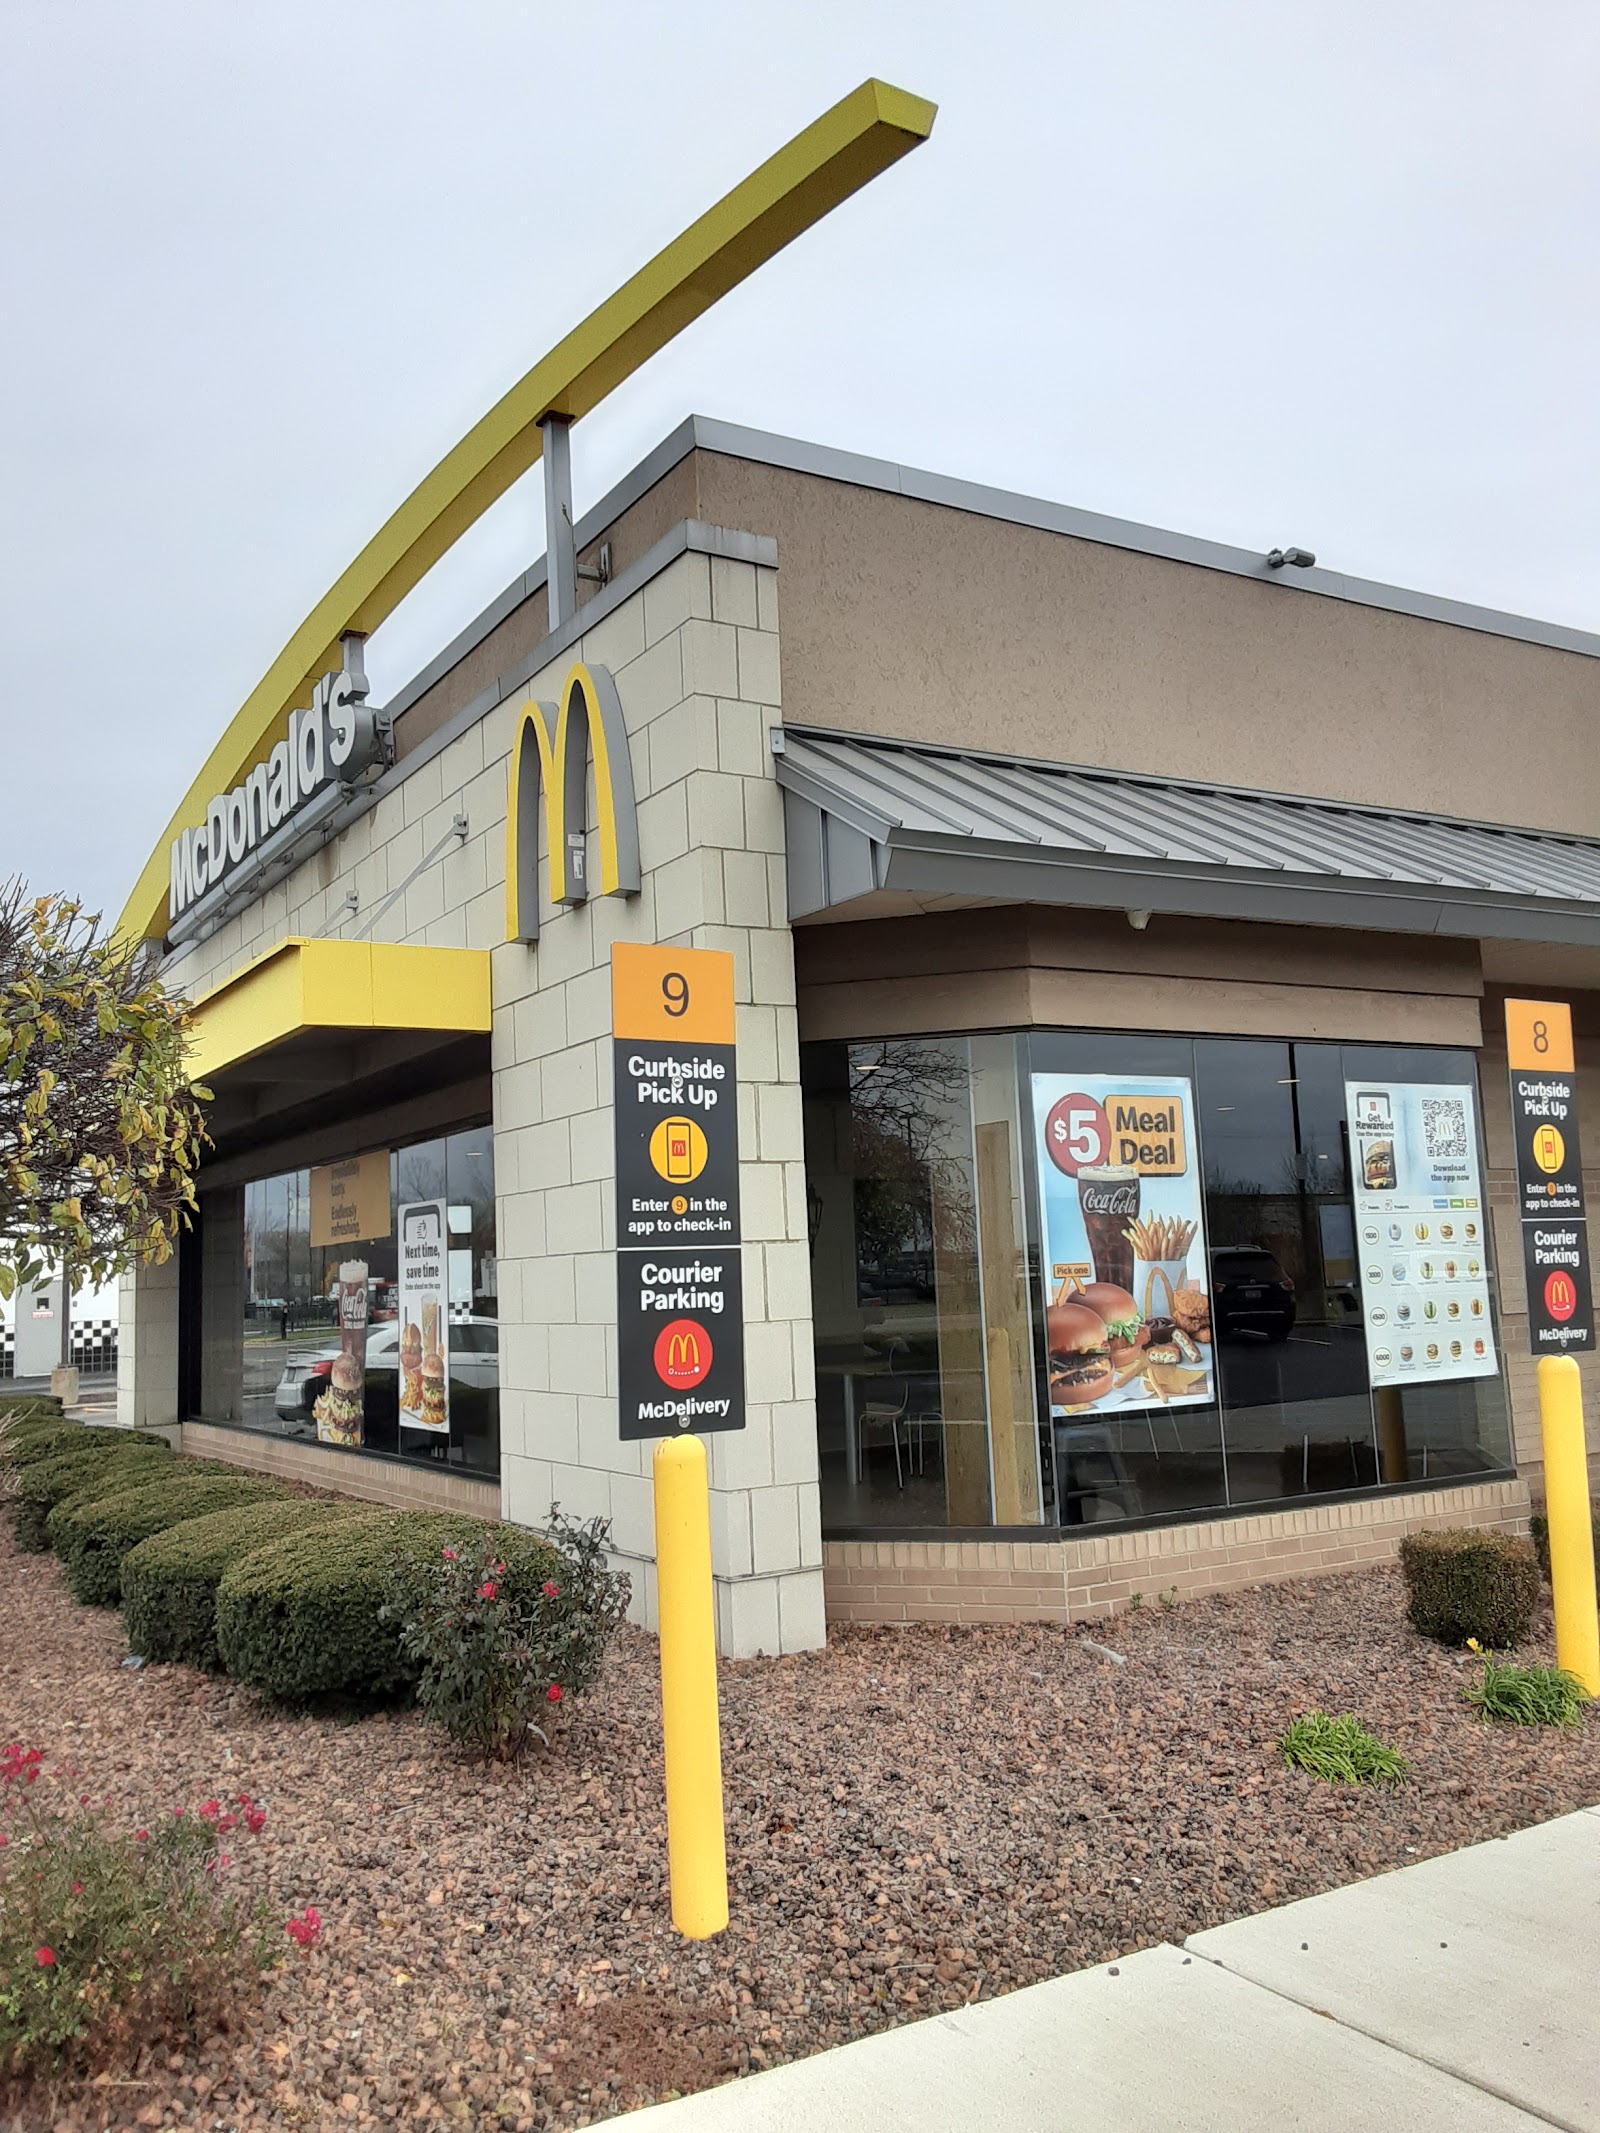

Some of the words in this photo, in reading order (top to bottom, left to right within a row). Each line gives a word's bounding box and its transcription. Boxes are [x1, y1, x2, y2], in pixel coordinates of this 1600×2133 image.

[169, 671, 357, 921] McDonald's
[662, 972, 689, 1017] 9
[1533, 1020, 1548, 1053] 8
[628, 1055, 725, 1079] Curbside
[637, 1081, 685, 1104] Pick
[688, 1084, 718, 1110] Up
[1518, 1080, 1570, 1098] Curbside
[1116, 1106, 1175, 1132] Meal
[1367, 1113, 1381, 1122] Get
[1524, 1099, 1550, 1116] Pick
[1551, 1101, 1568, 1120] Up
[1355, 1120, 1394, 1130] Rewarded
[1053, 1109, 1101, 1163] $5
[1120, 1138, 1175, 1165] Deal
[1433, 1164, 1466, 1172] Download
[1443, 1175, 1455, 1183] app
[1526, 1184, 1546, 1193] Enter
[1556, 1183, 1564, 1193] in
[1564, 1184, 1577, 1193] the
[632, 1198, 669, 1212] Enter
[676, 1200, 683, 1211] 9
[690, 1198, 702, 1211] in
[705, 1198, 727, 1211] the
[1083, 1187, 1137, 1214] Coca-Cola
[1526, 1200, 1540, 1211] app
[1541, 1199, 1548, 1208] to
[1549, 1197, 1580, 1208] check-in
[628, 1221, 654, 1236] app
[657, 1219, 671, 1232] to
[674, 1217, 731, 1231] check-in
[1534, 1229, 1577, 1246] Courier
[405, 1244, 420, 1259] Next
[421, 1242, 440, 1258] time,
[1535, 1248, 1579, 1267] Parking
[406, 1267, 421, 1279] save
[423, 1262, 439, 1278] time
[641, 1261, 723, 1285] Courier
[1057, 1266, 1072, 1275] Pick
[641, 1286, 724, 1313] Parking
[1539, 1327, 1587, 1341] McDelivery
[638, 1397, 730, 1419] McDelivery
